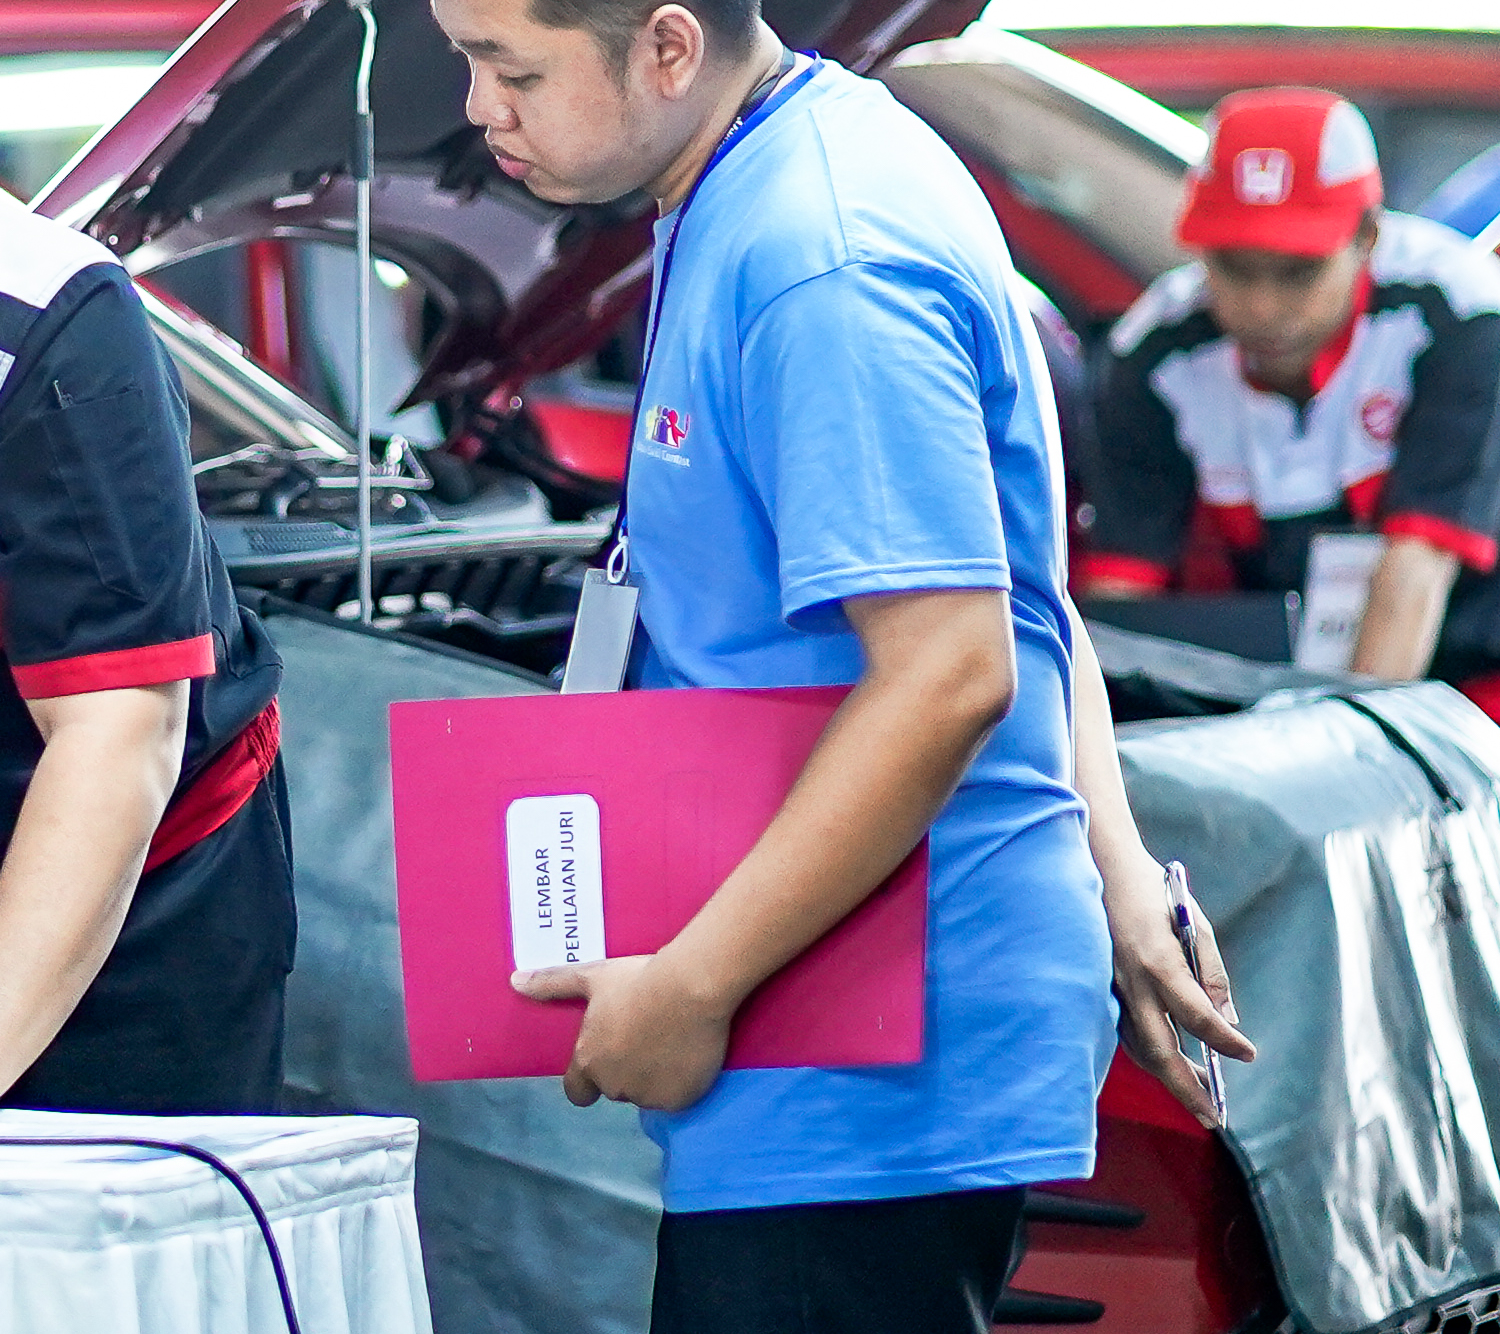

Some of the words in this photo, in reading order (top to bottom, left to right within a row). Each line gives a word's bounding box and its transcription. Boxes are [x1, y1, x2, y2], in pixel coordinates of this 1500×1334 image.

[559, 811, 575, 853] JURI
[535, 847, 553, 929] LEMBAR
[561, 859, 580, 963] PENILAIAN
